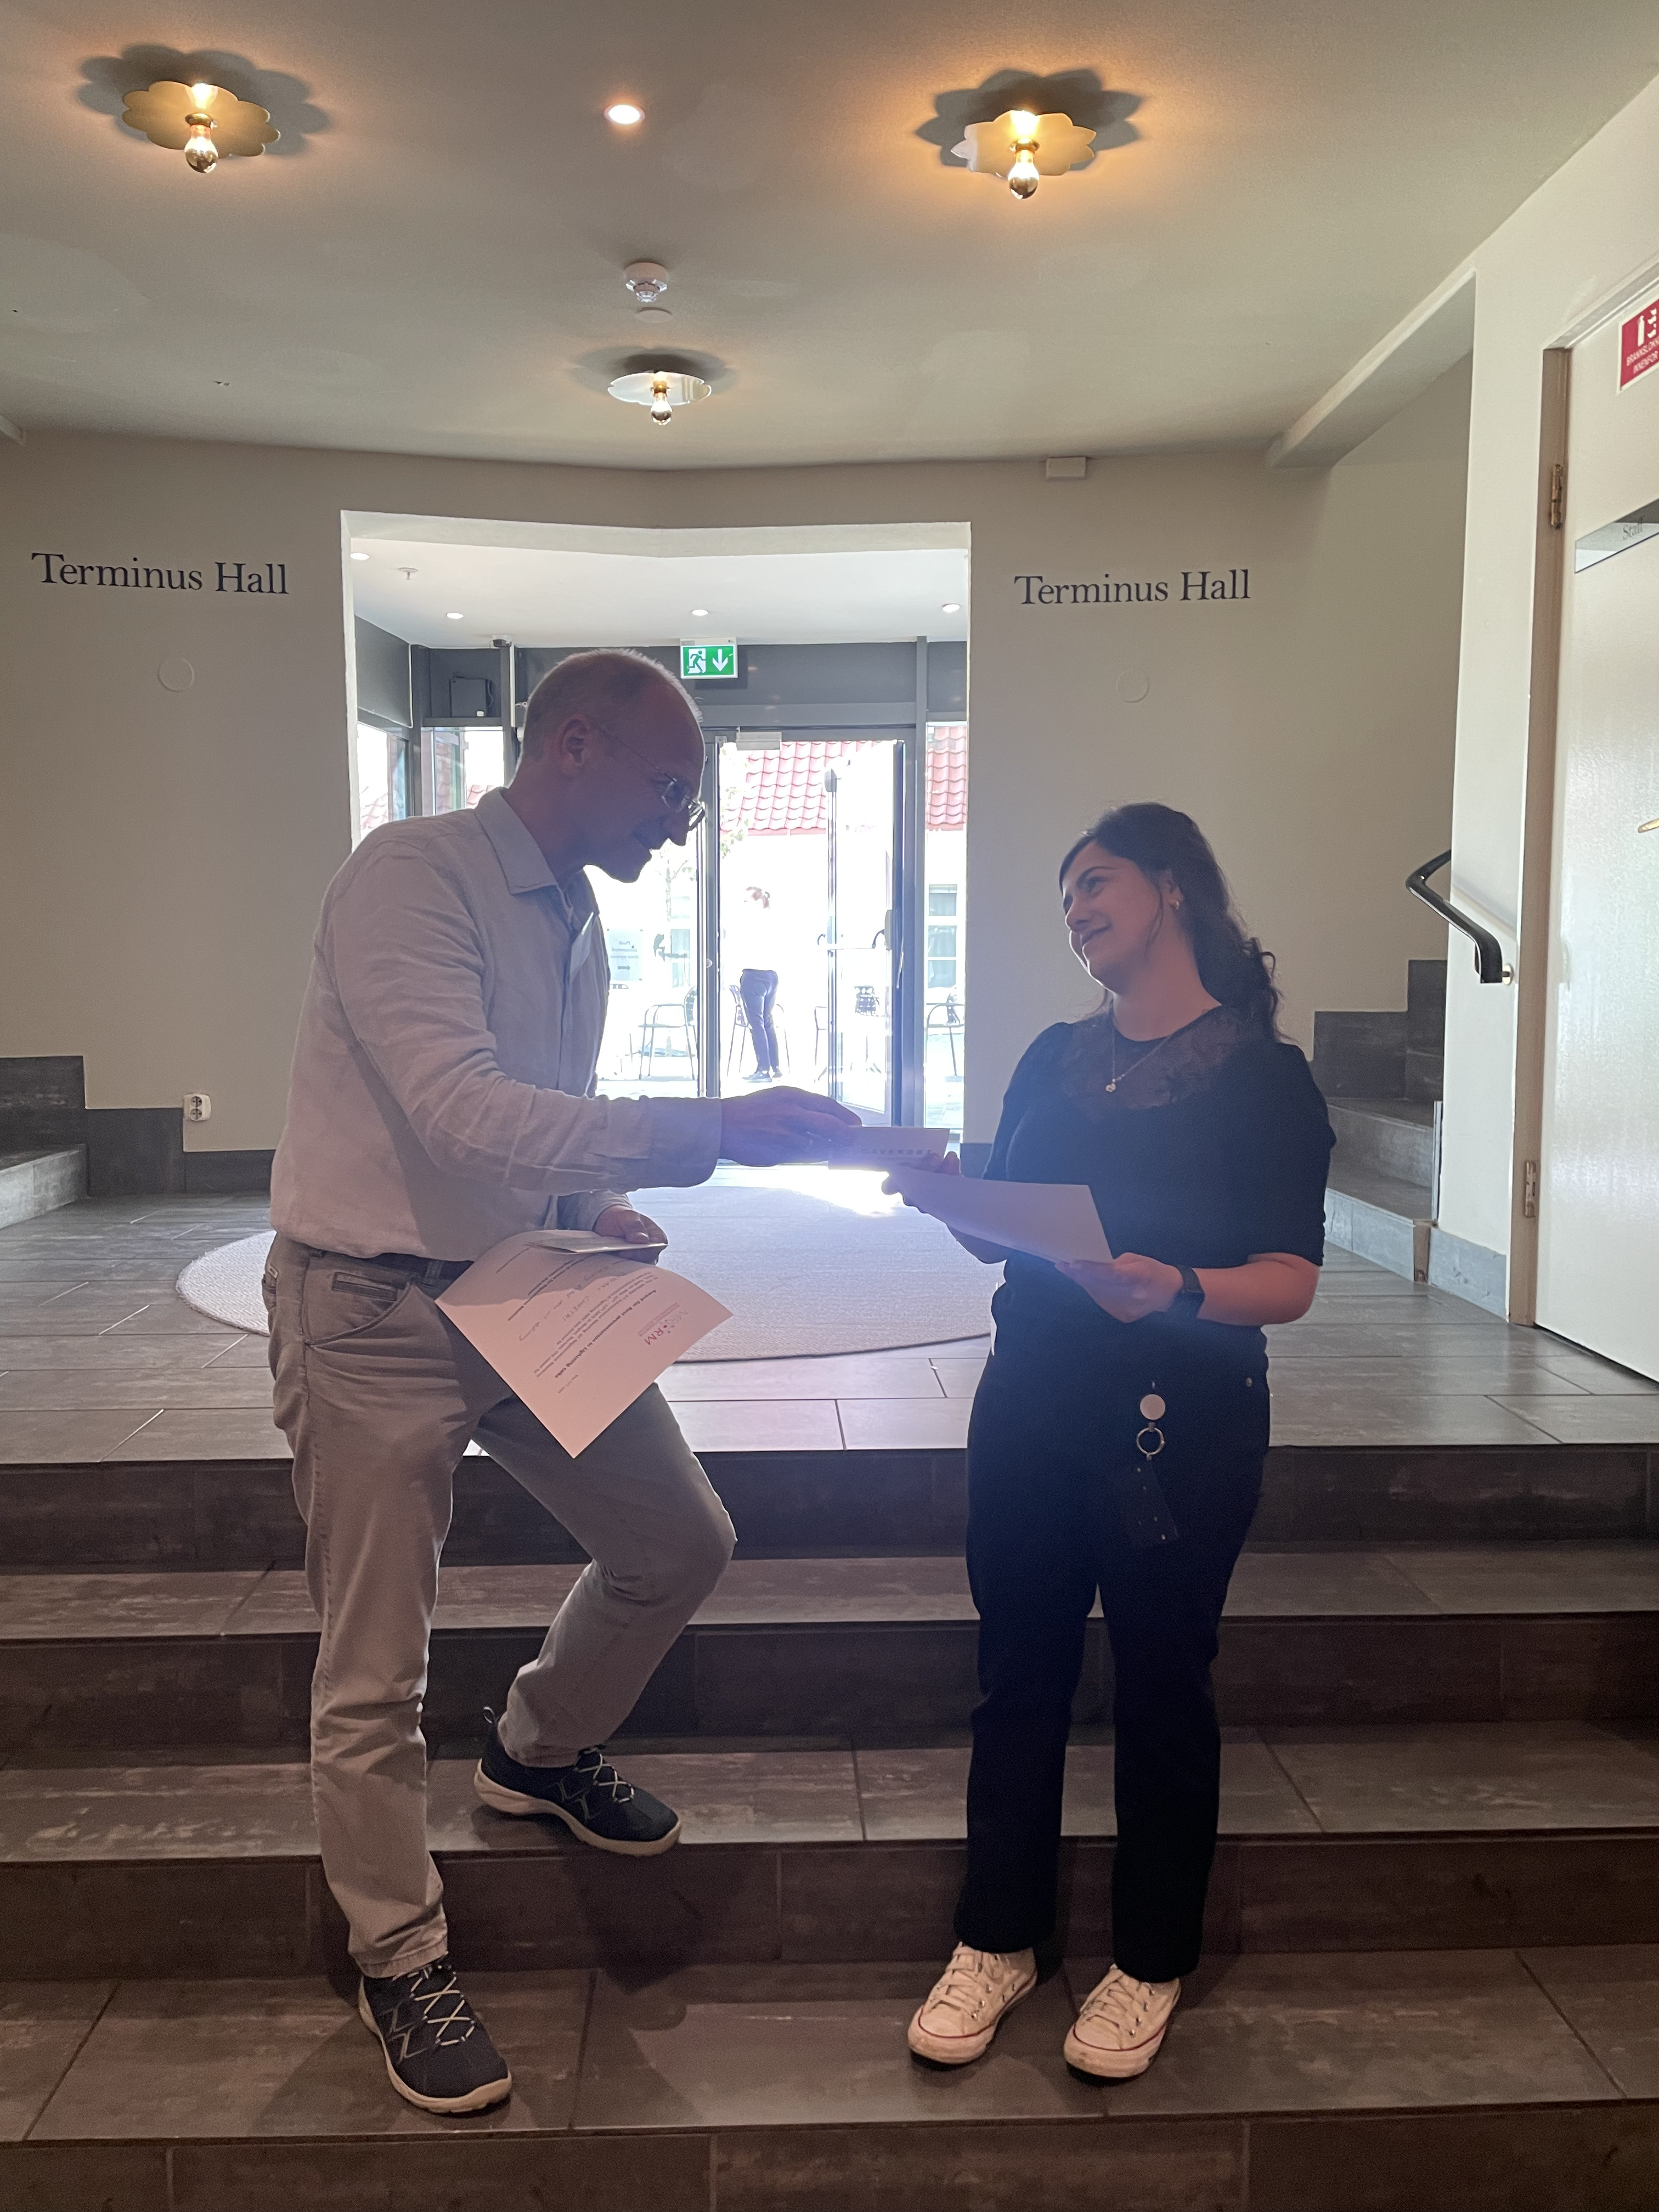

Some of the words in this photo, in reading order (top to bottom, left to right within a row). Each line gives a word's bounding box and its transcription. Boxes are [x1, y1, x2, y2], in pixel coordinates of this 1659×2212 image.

[31, 552, 202, 590] Terminus
[215, 562, 289, 594] Hall
[1014, 573, 1169, 605] Terminus
[1180, 569, 1251, 601] Hall
